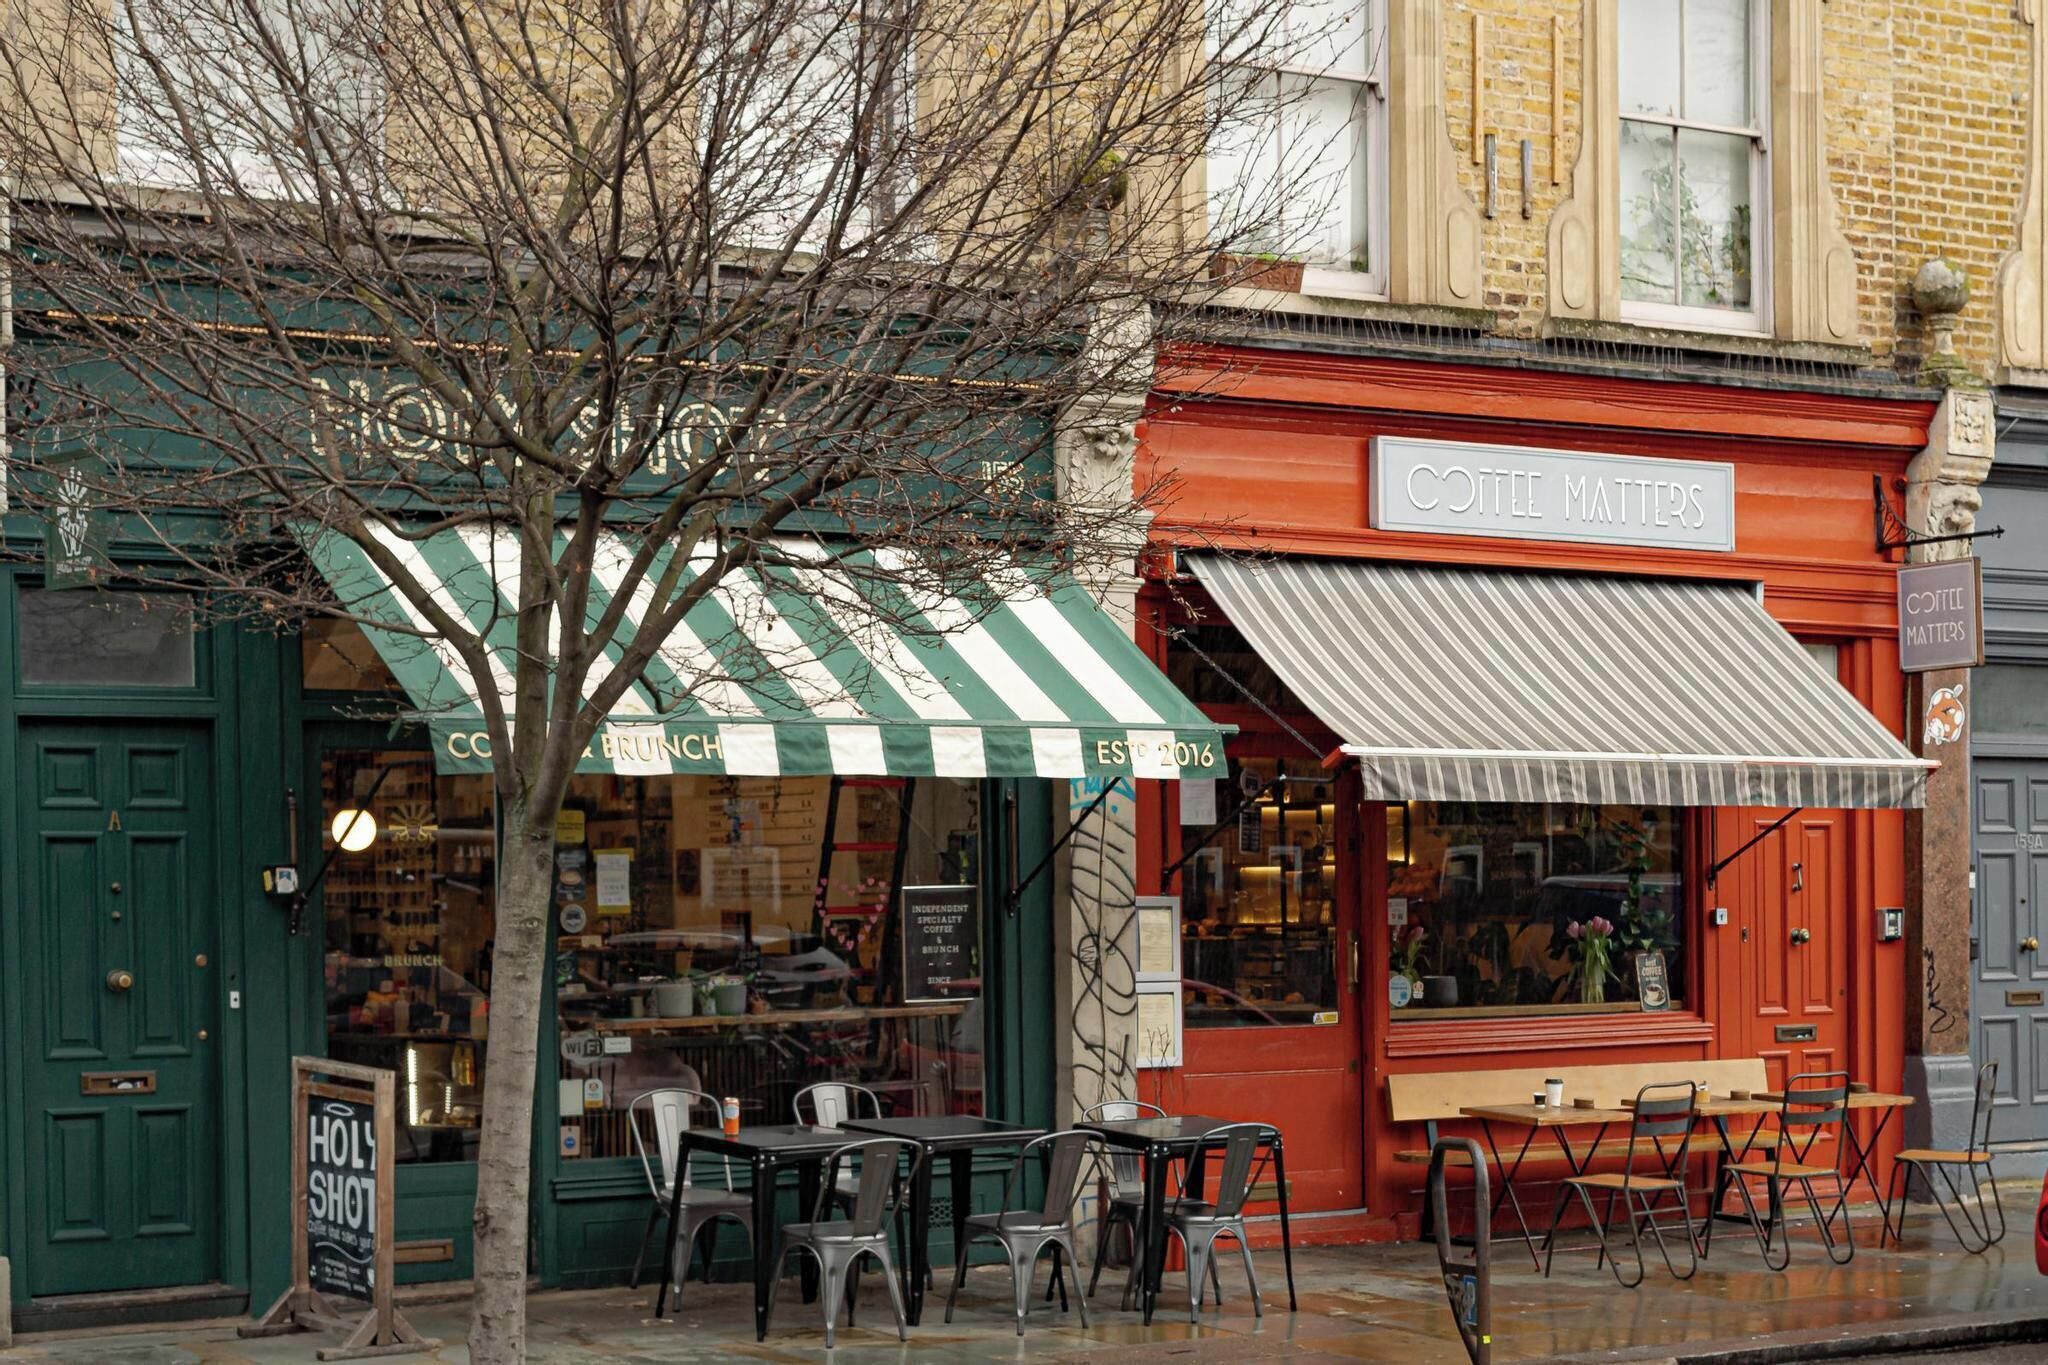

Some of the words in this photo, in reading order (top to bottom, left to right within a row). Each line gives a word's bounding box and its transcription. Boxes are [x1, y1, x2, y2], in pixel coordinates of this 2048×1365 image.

[1406, 463, 1543, 519] COFFEE
[1564, 473, 1706, 530] MATTERS
[1906, 587, 1965, 615] COFFEE
[1906, 620, 1966, 646] MATTERS
[602, 733, 724, 762] BRUNCH
[1157, 741, 1215, 769] 2016
[108, 810, 121, 831] A
[912, 905, 968, 913] INDEPENDENT
[918, 916, 962, 924] SPECIALTY
[384, 953, 443, 968] BRUNCH
[922, 945, 959, 953] BRUNCH
